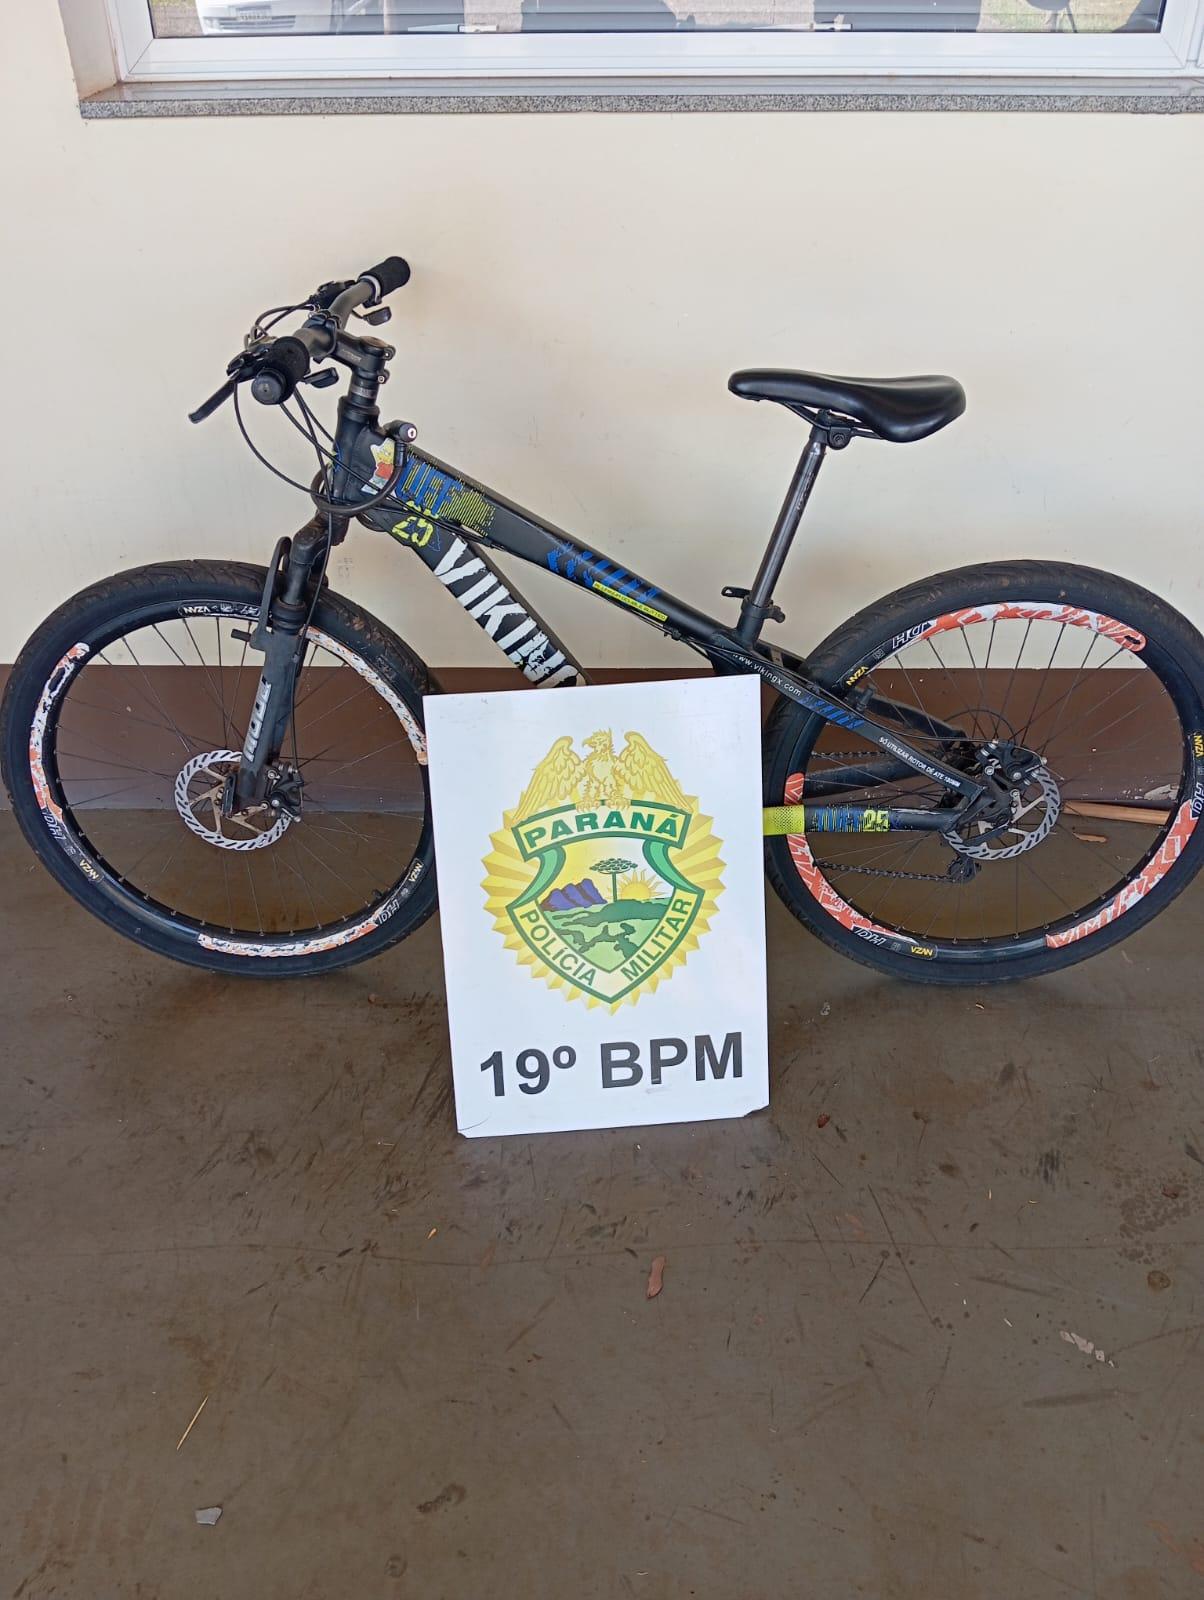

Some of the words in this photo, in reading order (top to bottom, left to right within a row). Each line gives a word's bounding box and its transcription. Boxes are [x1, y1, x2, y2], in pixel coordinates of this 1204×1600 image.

[733, 654, 802, 697] ww.vikingx.com
[523, 810, 680, 849] PARANÁ
[519, 911, 596, 987] POLÍCIA
[621, 898, 692, 983] MILITAR
[911, 946, 933, 956] VZAN
[600, 1032, 743, 1089] BPM
